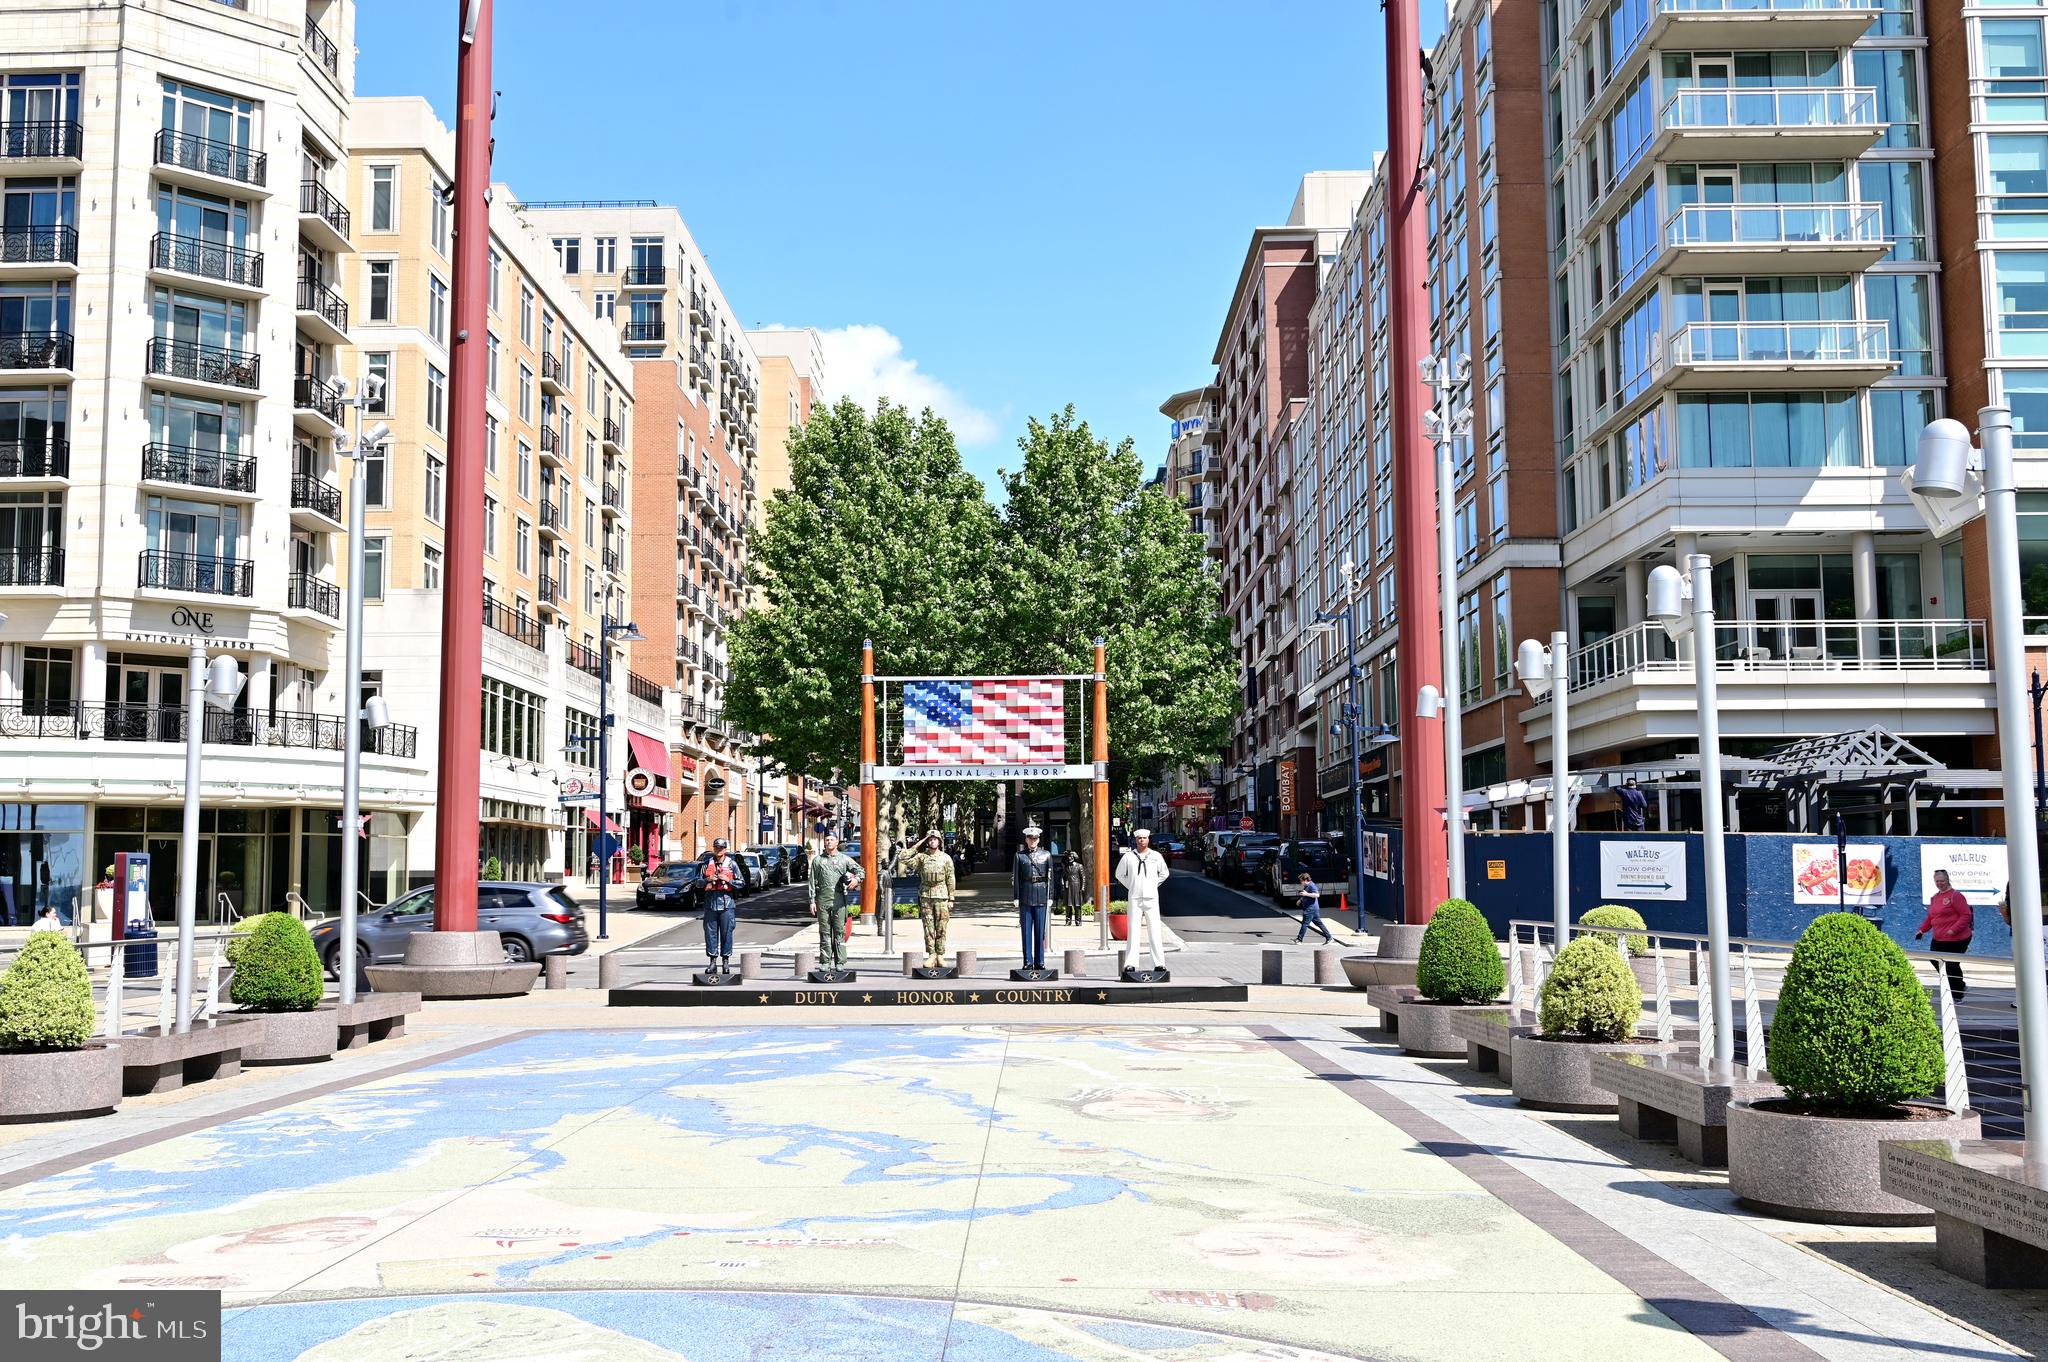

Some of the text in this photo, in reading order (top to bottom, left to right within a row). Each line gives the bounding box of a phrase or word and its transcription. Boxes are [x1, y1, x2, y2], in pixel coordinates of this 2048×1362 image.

[171, 605, 215, 634] ONE
[125, 633, 255, 650] NATIONAL HARBOR
[909, 768, 1059, 777] NATIONAL HARBOR
[1281, 765, 1291, 812] BOMBAY
[1626, 849, 1661, 860] WALRUS
[1949, 853, 1988, 864] WALRUS
[795, 989, 1074, 1004] DUTY HONOR COUNTRY
[1979, 1181, 1995, 1193] PERCH
[1951, 1185, 1977, 1201] NATIONAL
[1979, 1195, 1988, 1204] AIR
[1991, 1199, 2001, 1208] AND
[2004, 1203, 2021, 1215] SPACE
[2023, 1210, 2048, 1224] MUSEUM
[1963, 1202, 1980, 1215] STATES
[2002, 1216, 2024, 1230] UNITED
[2025, 1223, 2045, 1238] STATES
